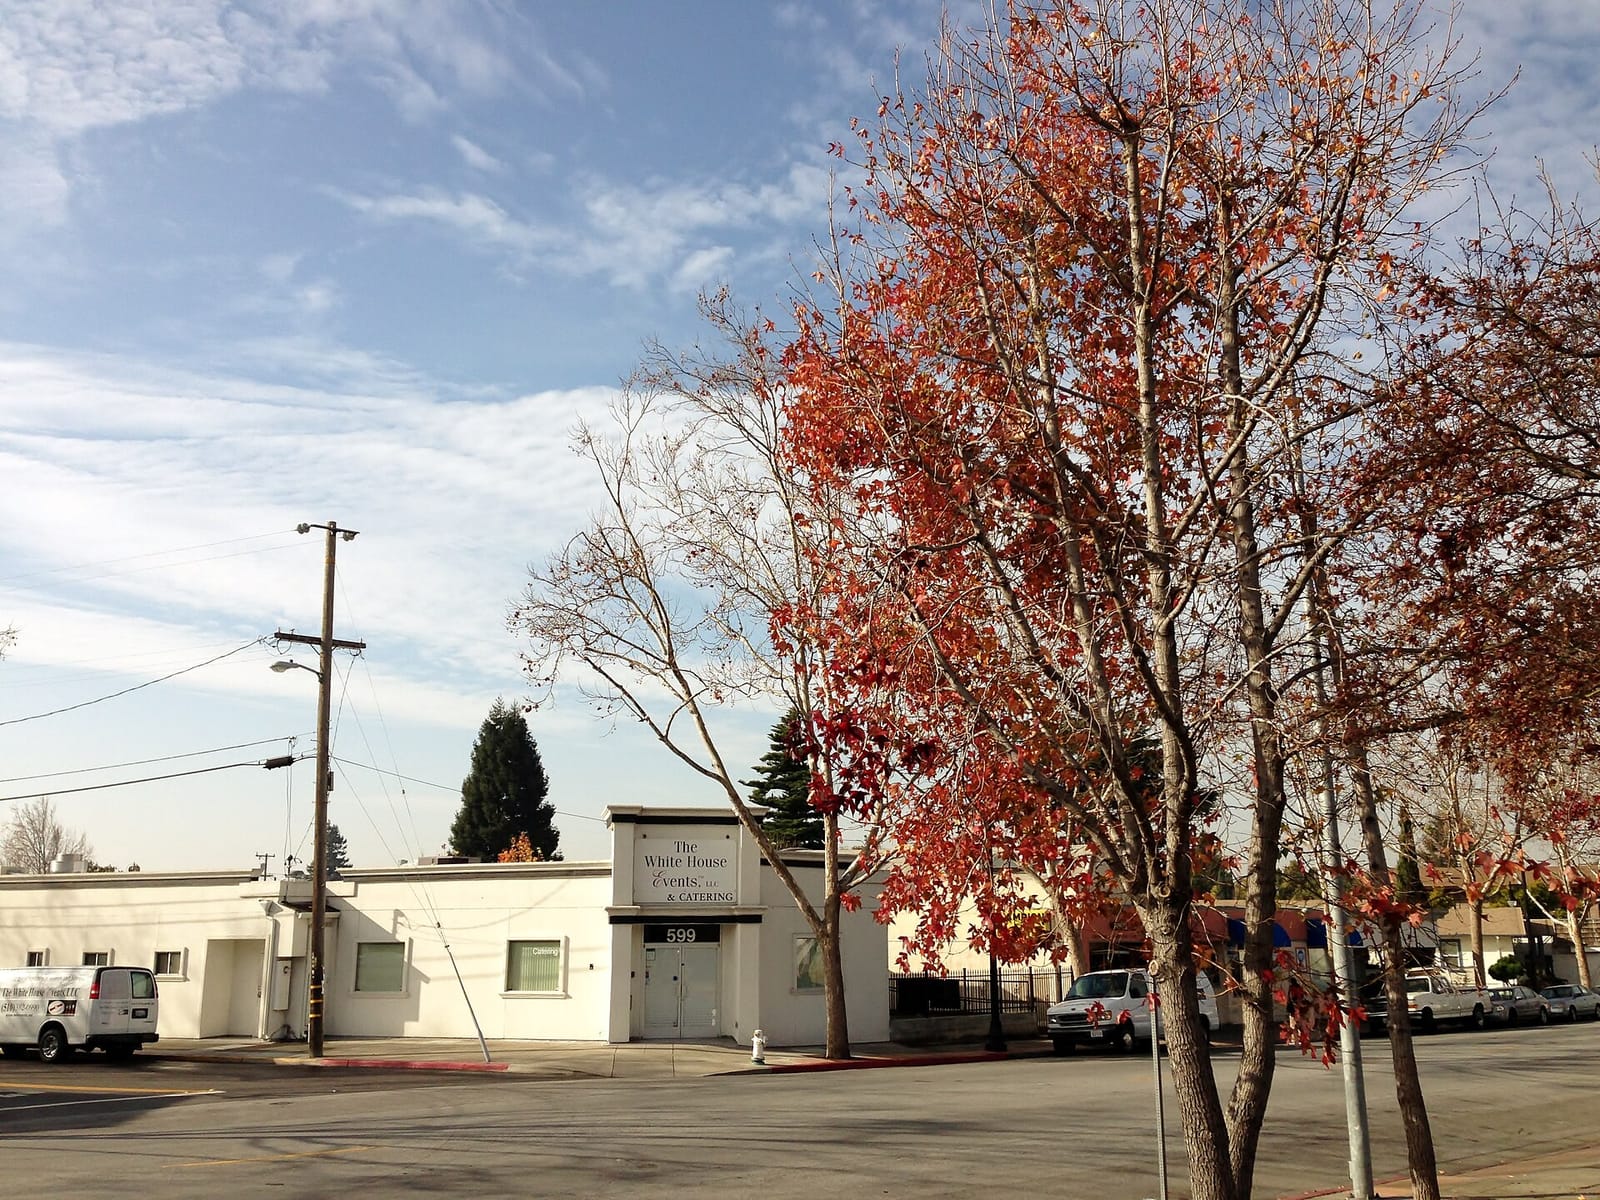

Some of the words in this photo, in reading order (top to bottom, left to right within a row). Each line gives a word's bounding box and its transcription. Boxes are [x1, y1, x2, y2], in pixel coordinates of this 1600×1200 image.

[674, 841, 698, 853] The
[645, 855, 682, 868] White
[687, 855, 728, 868] House
[667, 893, 675, 901] &
[679, 892, 733, 901] CATERING
[666, 928, 696, 943] 599
